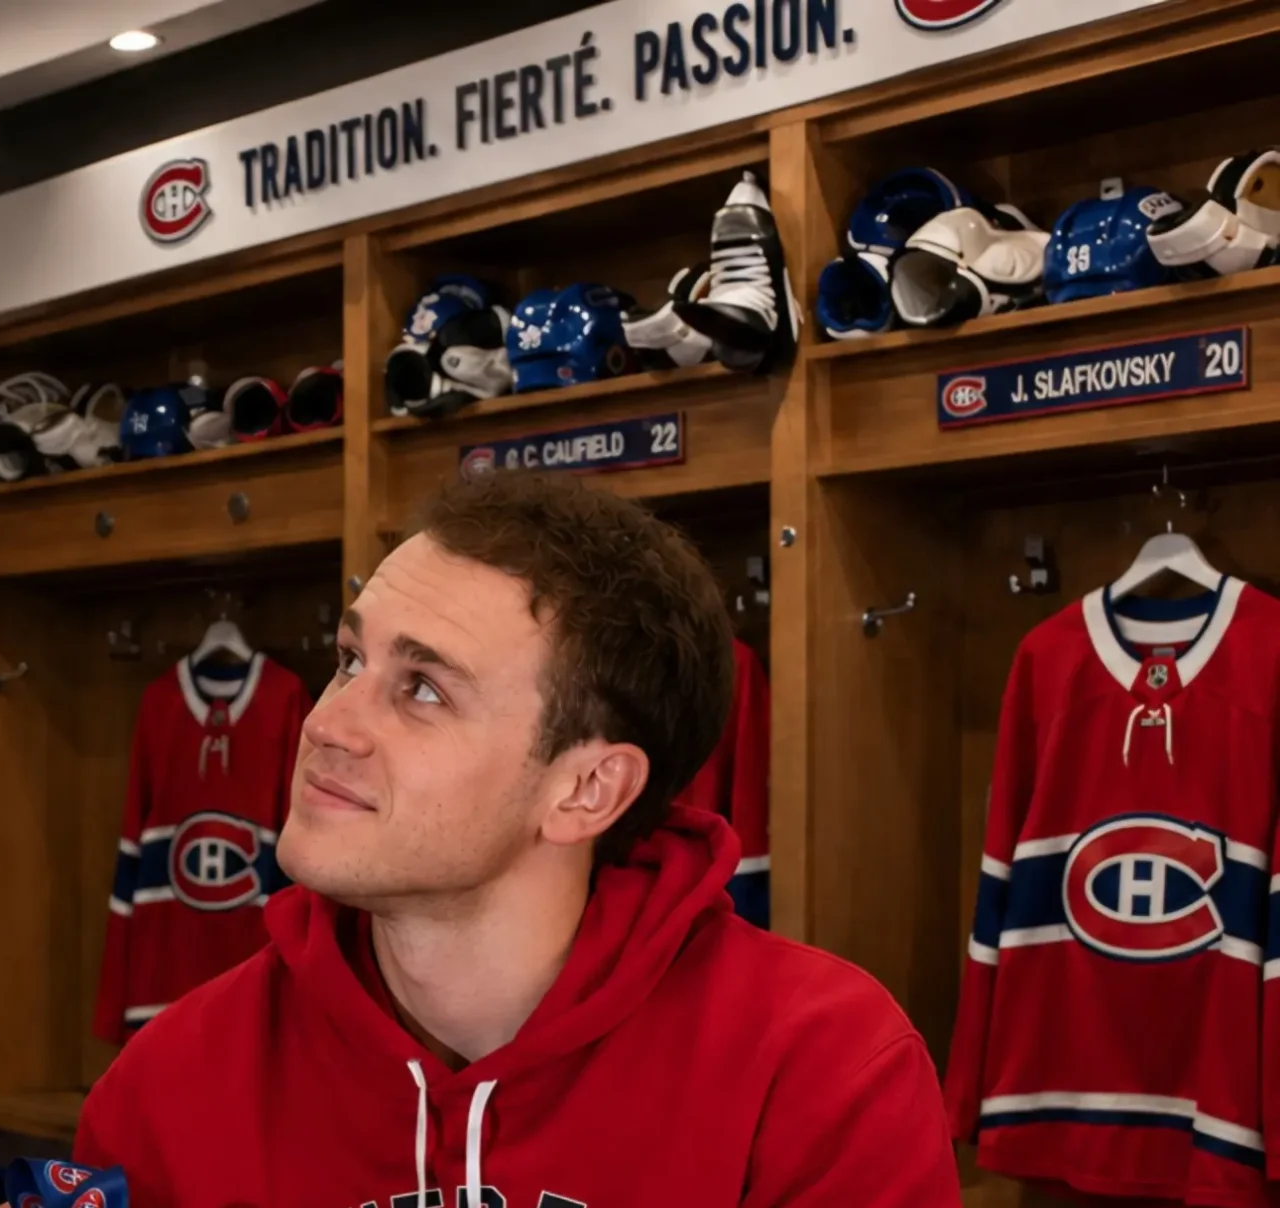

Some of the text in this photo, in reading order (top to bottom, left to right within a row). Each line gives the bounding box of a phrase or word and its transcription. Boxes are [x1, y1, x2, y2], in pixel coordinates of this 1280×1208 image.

[238, 0, 854, 207] TRADITION. FIERTÉ. PASSION.
[1011, 374, 1029, 403] J.
[1033, 351, 1176, 401] SLAFKOVSKY
[1204, 340, 1240, 378] 20
[650, 421, 678, 454] 22
